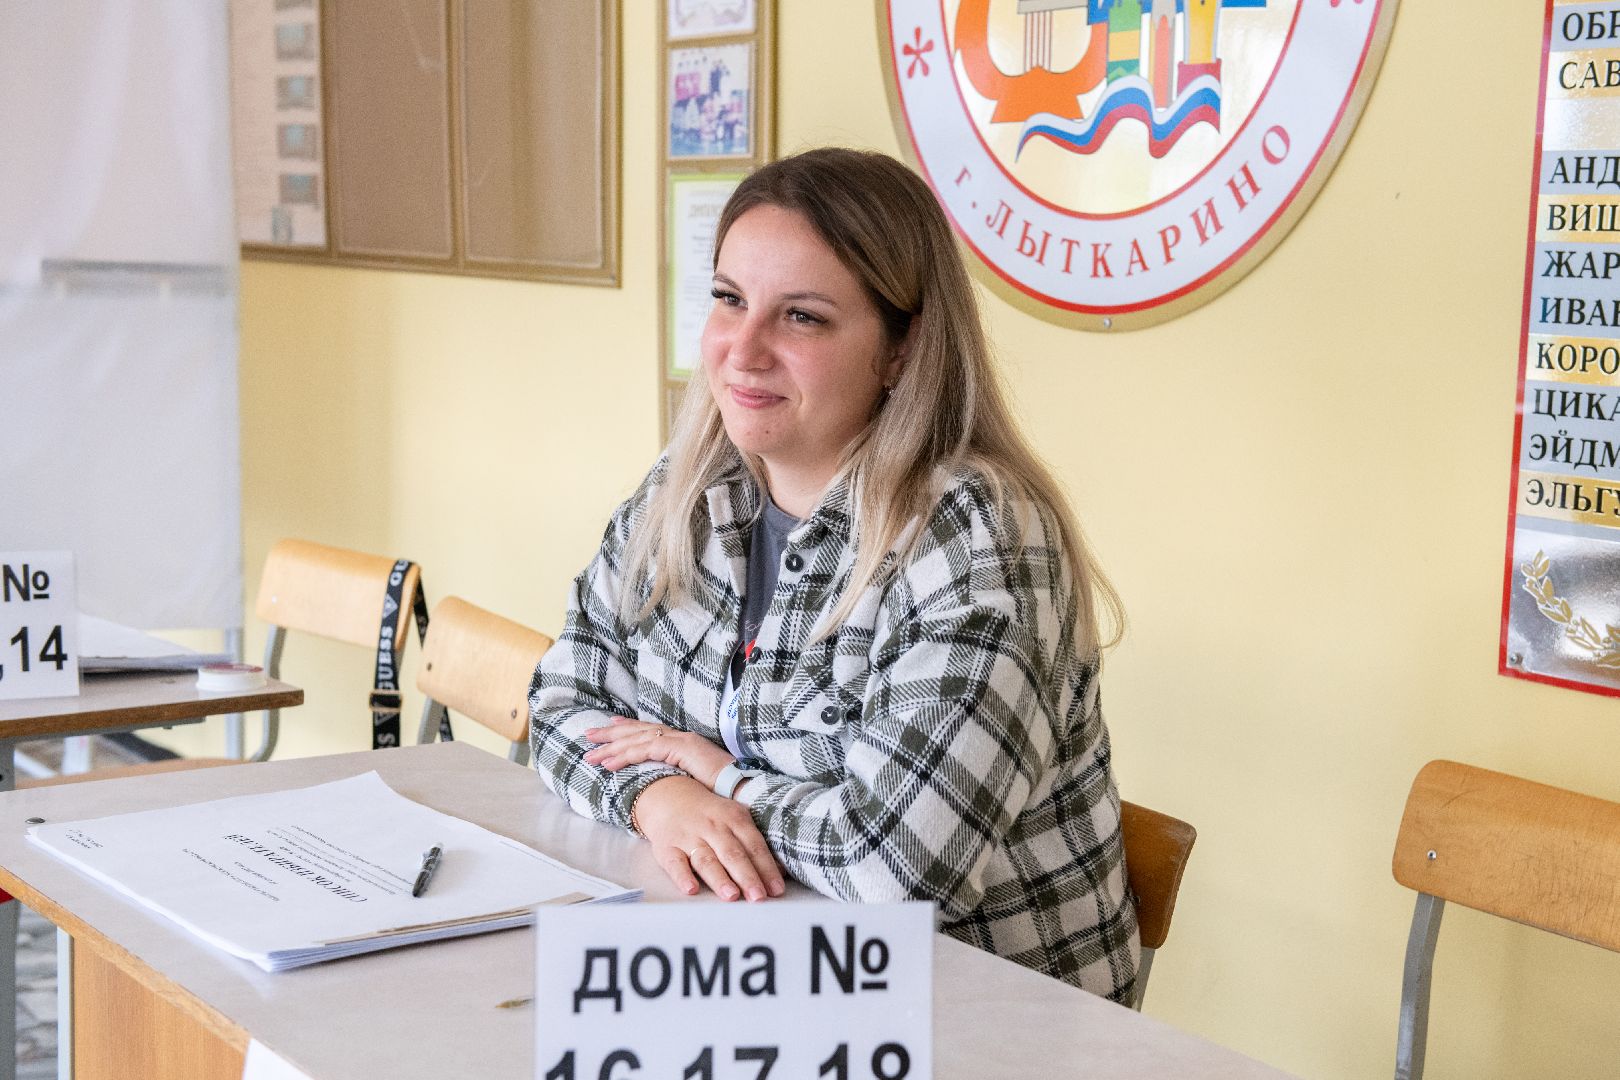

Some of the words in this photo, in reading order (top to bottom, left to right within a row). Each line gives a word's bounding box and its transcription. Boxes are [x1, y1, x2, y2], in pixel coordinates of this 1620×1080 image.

[1548, 156, 1620, 190] АНД
[1535, 342, 1620, 375] КОРО
[2, 563, 50, 602] №
[572, 943, 777, 1014] дома
[810, 924, 891, 994] №
